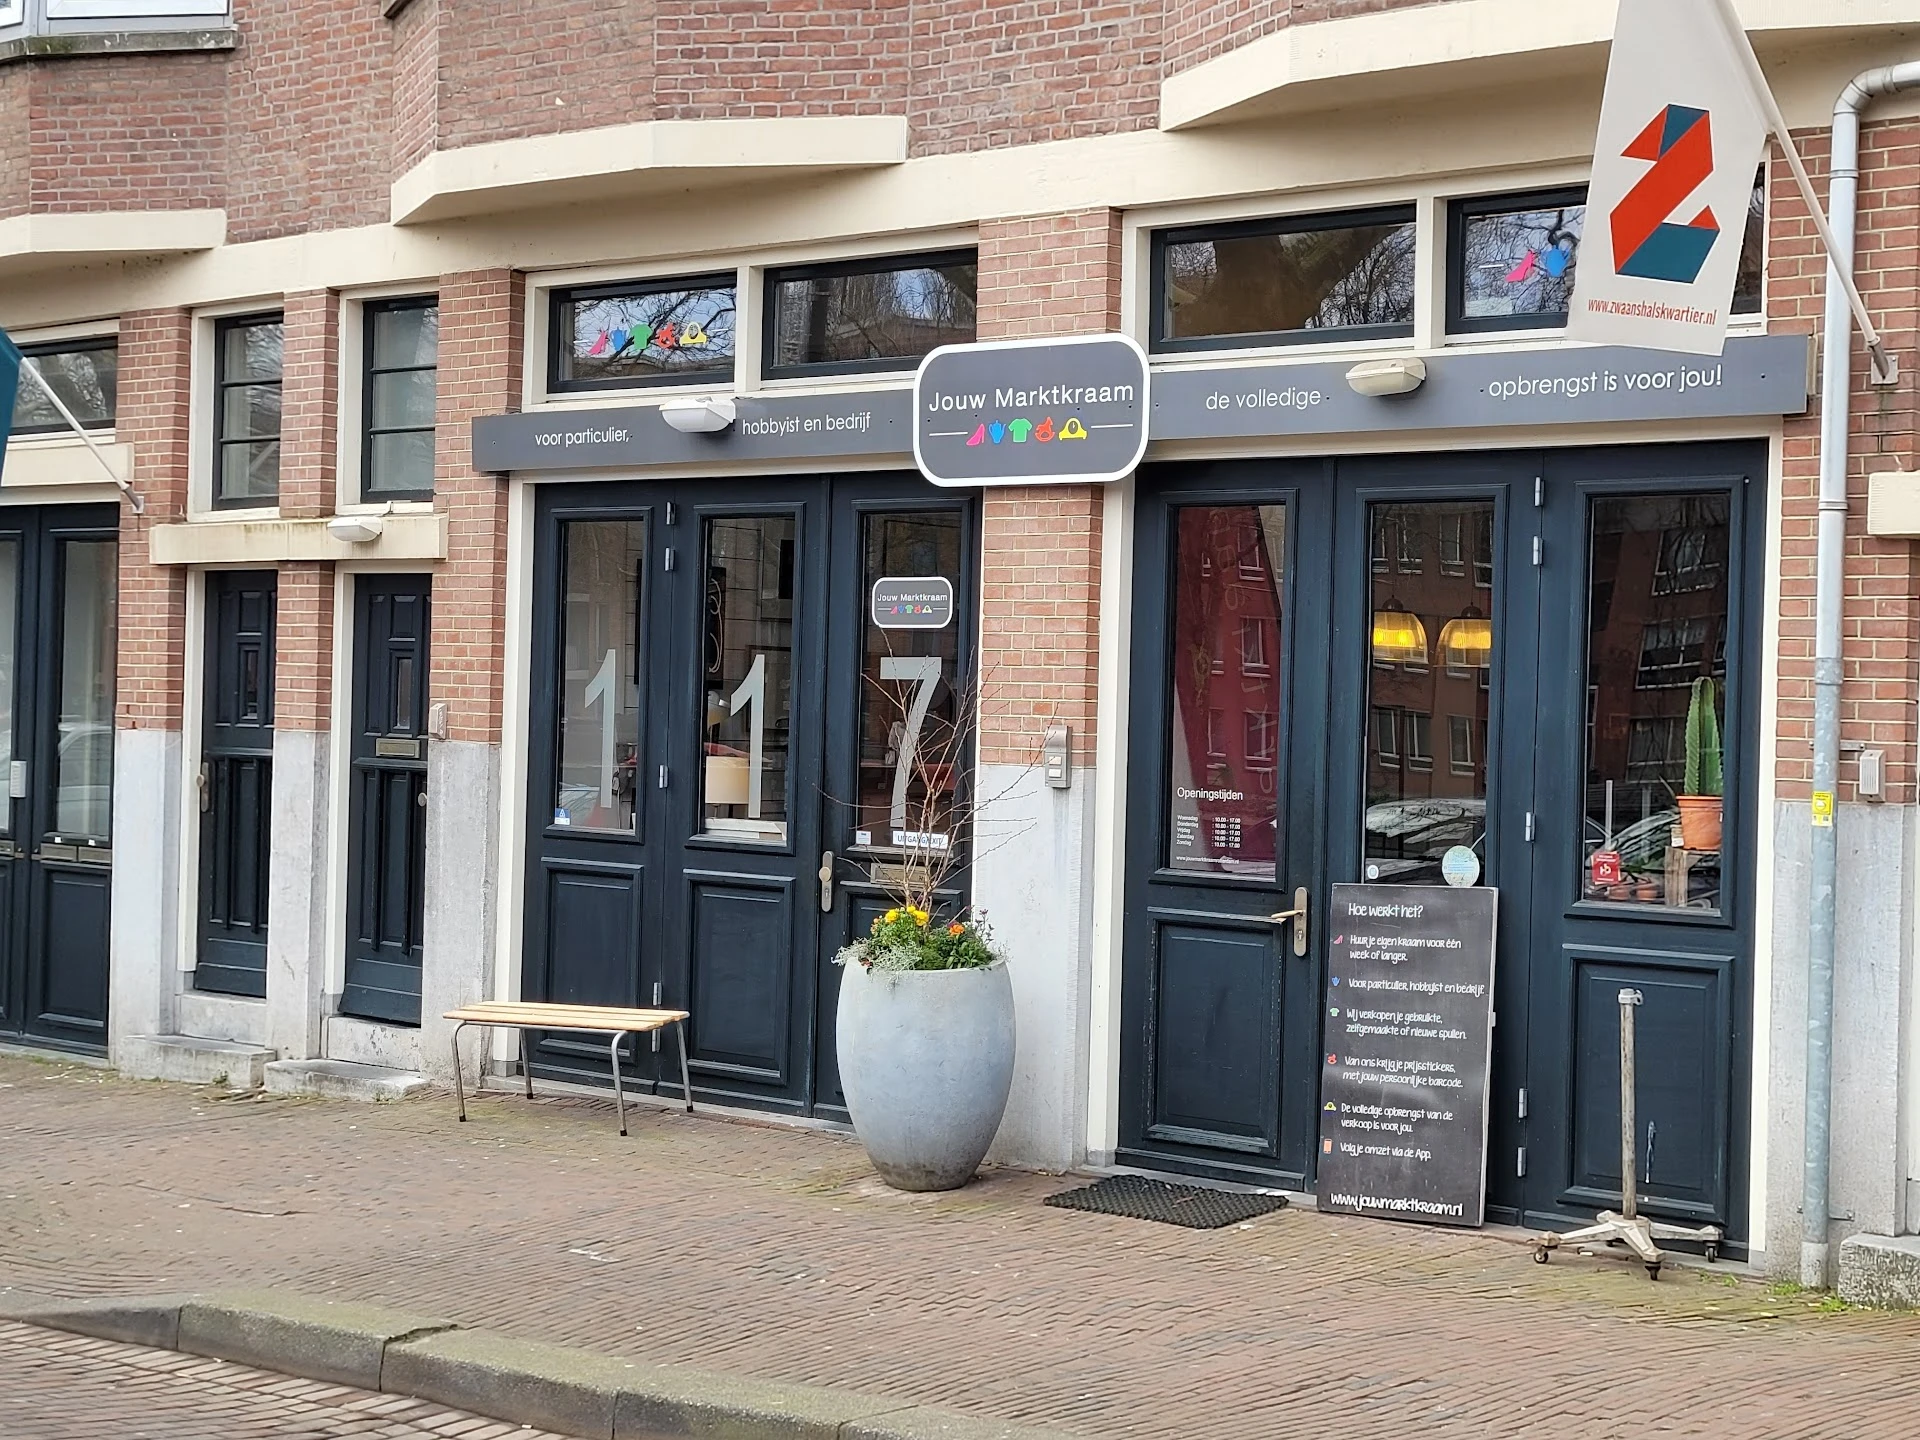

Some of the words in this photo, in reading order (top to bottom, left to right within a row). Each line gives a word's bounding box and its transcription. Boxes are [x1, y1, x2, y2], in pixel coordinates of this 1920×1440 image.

[1588, 298, 1718, 326] www.zwaanshalskwartier.nl
[1206, 391, 1230, 410] de
[1235, 386, 1321, 410] volledige
[1488, 371, 1598, 401] opbrengst
[1603, 370, 1618, 392] is
[1623, 371, 1675, 390] voor
[1678, 363, 1723, 393] jou!
[928, 391, 987, 412] Jouw
[995, 383, 1134, 408] Marktkraam
[534, 432, 562, 446] voor
[565, 426, 629, 448] particulier,
[742, 416, 800, 436] hobbyist
[803, 418, 822, 432] en
[825, 411, 871, 433] bedrijf
[877, 593, 899, 602] Jouw
[900, 593, 948, 602] Marktkraam
[1177, 787, 1243, 801] Openingstijden
[1348, 903, 1367, 916] Hoe
[1368, 904, 1400, 917] werkt
[1401, 905, 1424, 918] het?
[1377, 936, 1397, 950] eigen
[1398, 937, 1425, 947] kraam
[1426, 939, 1445, 948] voor
[1349, 950, 1370, 960] week
[1371, 950, 1381, 960] of
[1348, 978, 1367, 988] Voor
[1409, 981, 1444, 996] hobbyist
[1444, 984, 1456, 993] en
[1346, 1008, 1358, 1022] Wij
[1359, 1010, 1396, 1023] verkopen
[1345, 1023, 1399, 1037] zelfgemaakte
[1400, 1026, 1411, 1036] of
[1410, 1027, 1438, 1038] nieuwe
[1344, 1056, 1360, 1066] Van
[1360, 1058, 1376, 1068] ons
[1376, 1058, 1396, 1072] krijg
[1342, 1070, 1361, 1080] met
[1358, 1072, 1380, 1084] jouw
[1379, 1074, 1428, 1088] persoonlijke
[1341, 1103, 1351, 1113] De
[1351, 1104, 1383, 1118] volledige
[1383, 1107, 1425, 1121] opbrengst
[1426, 1111, 1442, 1120] van
[1442, 1111, 1454, 1121] de
[1341, 1119, 1373, 1131] verkoop
[1373, 1120, 1380, 1130] is
[1380, 1122, 1399, 1132] voor
[1340, 1142, 1357, 1156] Volg
[1364, 1146, 1391, 1156] omzet
[1391, 1147, 1403, 1157] via
[1403, 1148, 1414, 1158] de
